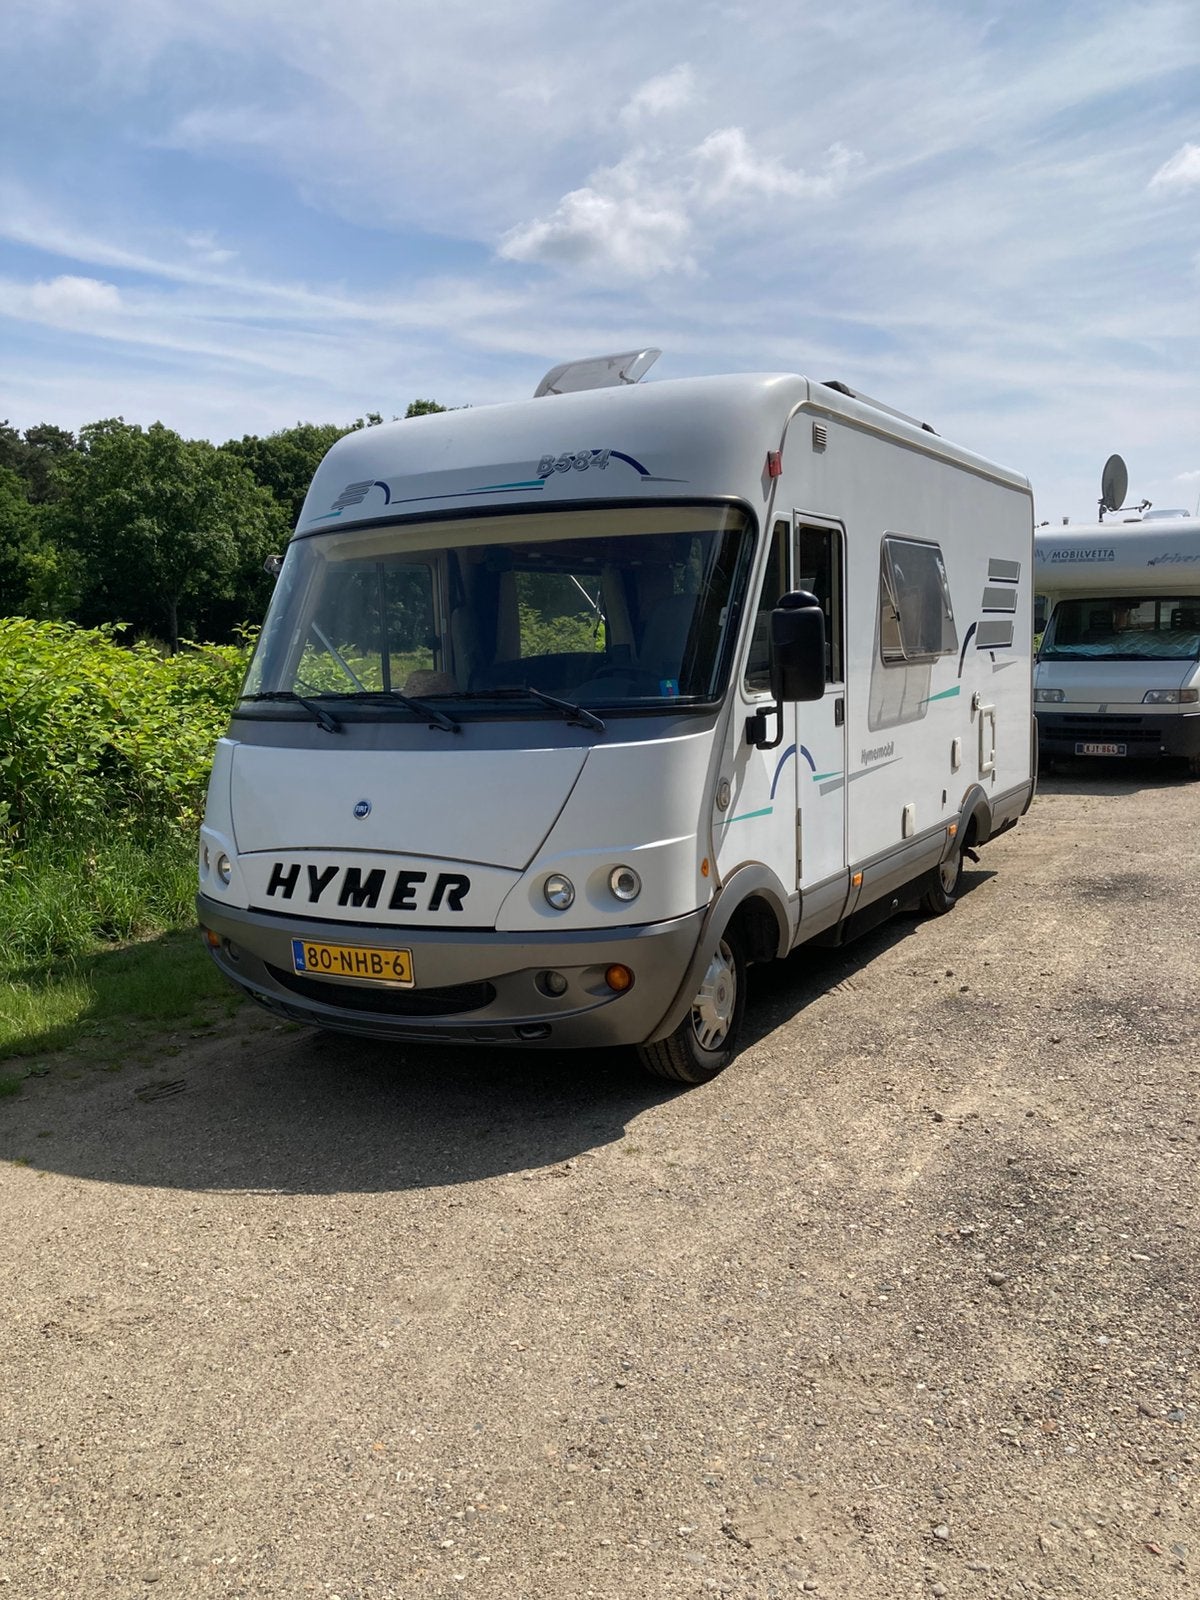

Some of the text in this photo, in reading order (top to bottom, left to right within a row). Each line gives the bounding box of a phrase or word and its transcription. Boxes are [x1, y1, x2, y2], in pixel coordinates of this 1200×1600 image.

[536, 449, 610, 475] B584
[1051, 549, 1115, 559] MOBILVETTA
[266, 863, 471, 911] HYMER
[307, 947, 405, 976] 80-NHB-6
